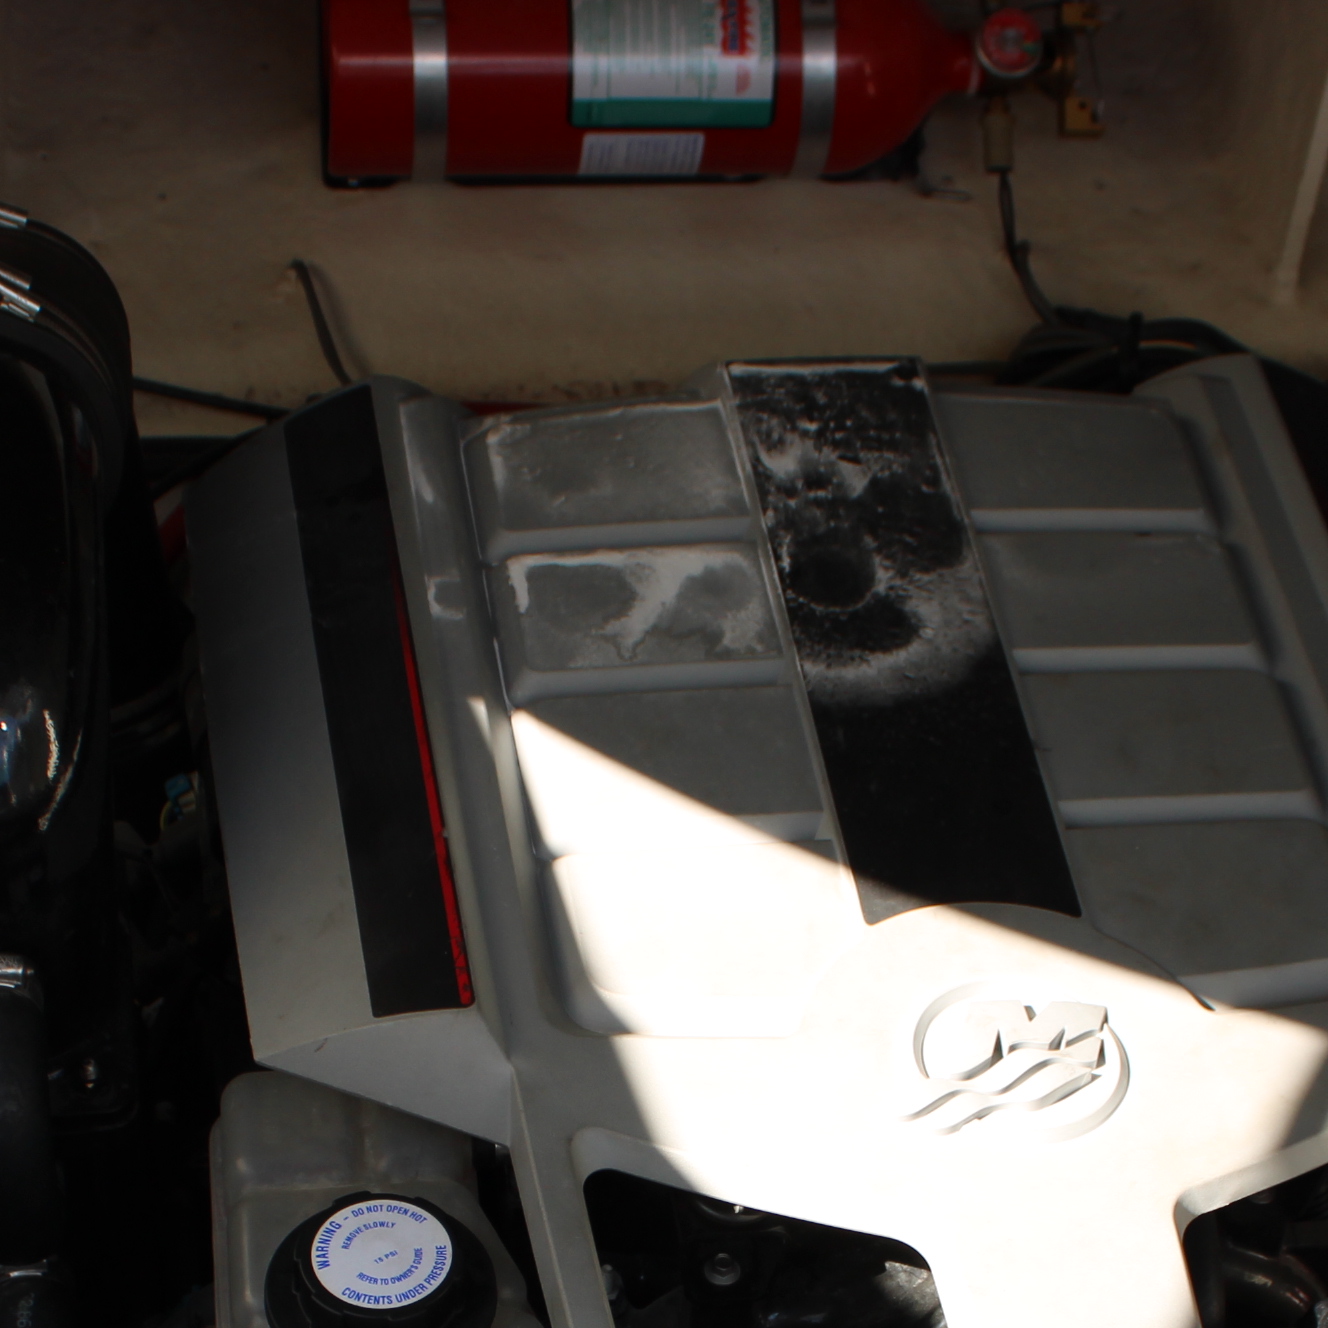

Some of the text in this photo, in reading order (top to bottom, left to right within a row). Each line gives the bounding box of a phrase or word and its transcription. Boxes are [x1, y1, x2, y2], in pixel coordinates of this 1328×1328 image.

[315, 1220, 342, 1270] WARNING
[351, 1209, 365, 1218] DO
[366, 1204, 384, 1213] NOT
[386, 1204, 410, 1216] OPEN
[409, 1211, 428, 1225] HOT
[341, 1220, 396, 1250] REMOVE SLOWLY
[341, 1244, 447, 1306] CONTENTS UNDER PRESSURE
[356, 1247, 423, 1286] REFER TO OWNER'S GUIDE
